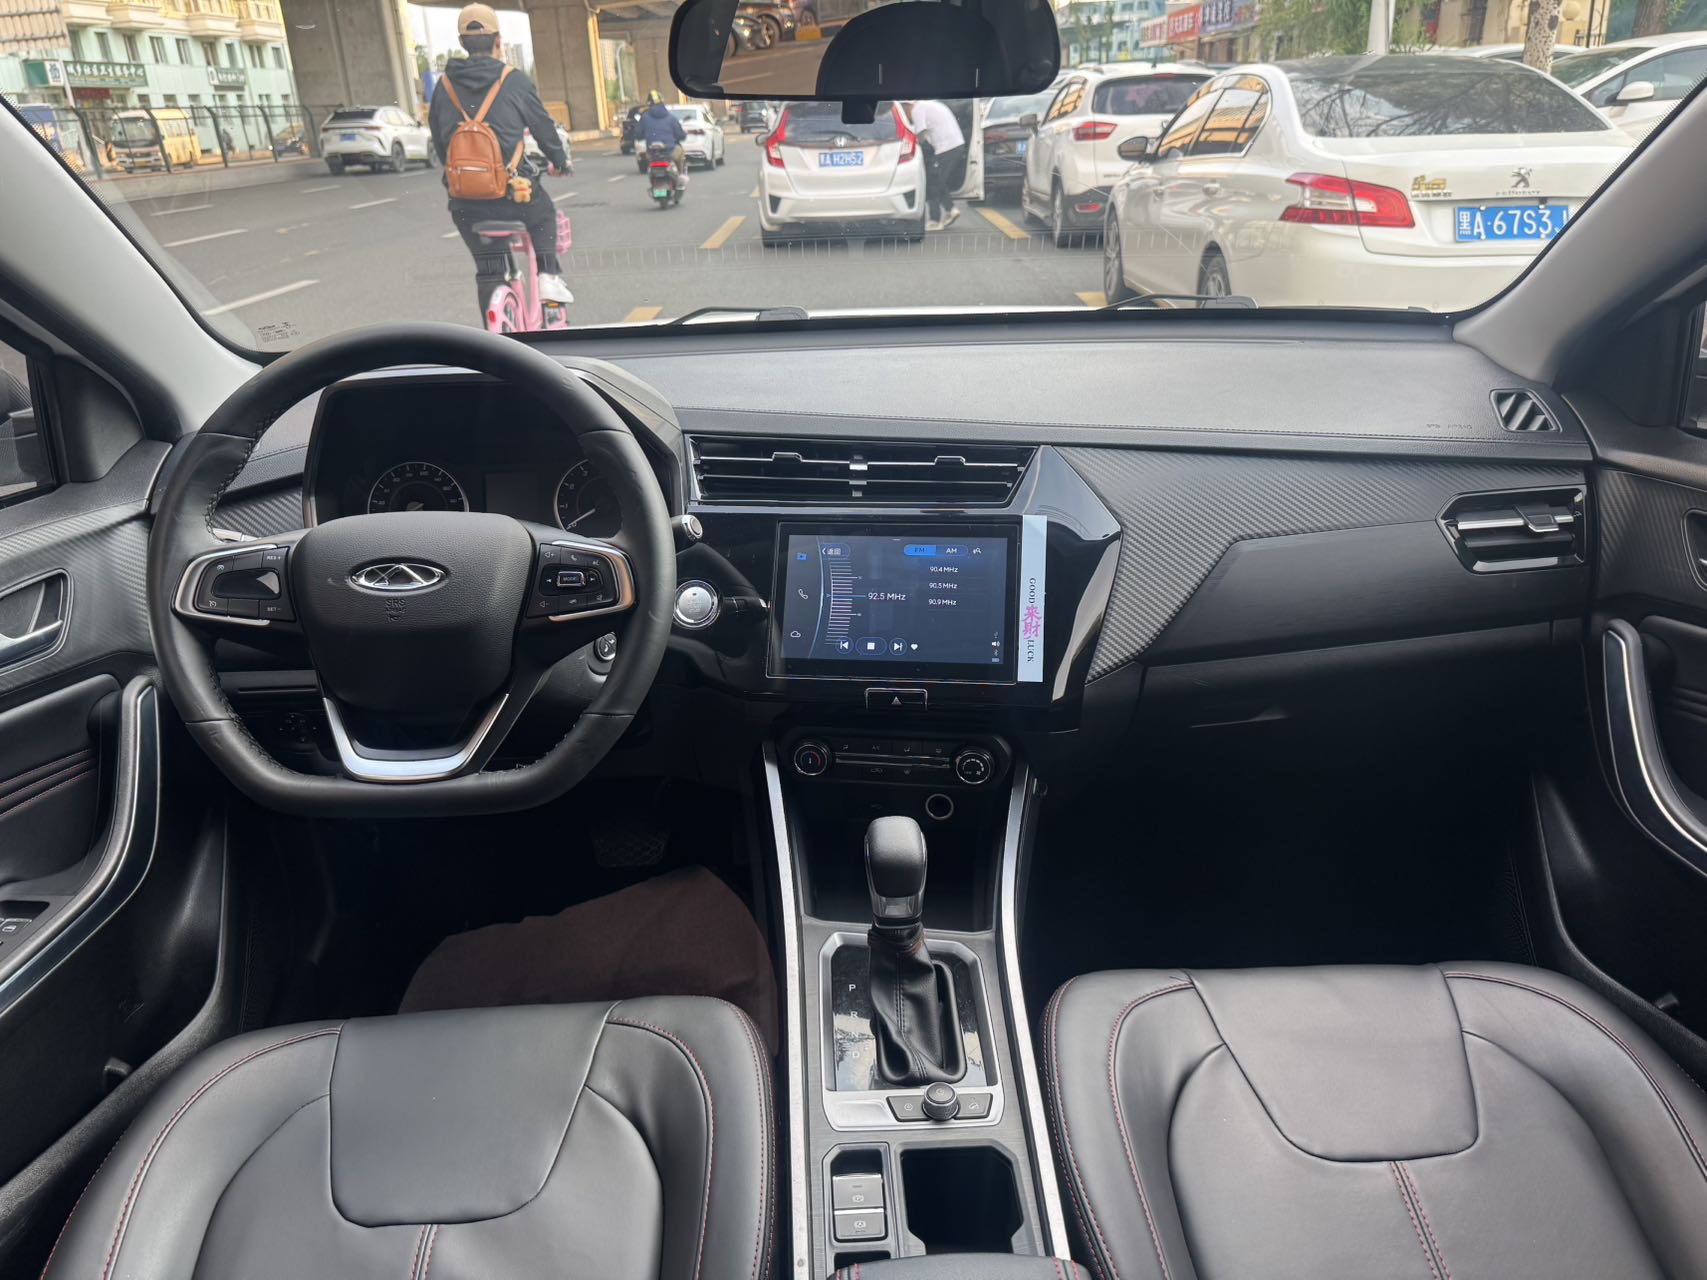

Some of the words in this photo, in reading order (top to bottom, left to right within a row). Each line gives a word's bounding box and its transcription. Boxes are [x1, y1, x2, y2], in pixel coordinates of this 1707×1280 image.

[1028, 577, 1037, 604] GOOD
[867, 592, 885, 600] 92.5
[886, 593, 906, 601] MHz
[1027, 639, 1036, 662] LUCK
[848, 983, 856, 992] P
[850, 1010, 858, 1018] R
